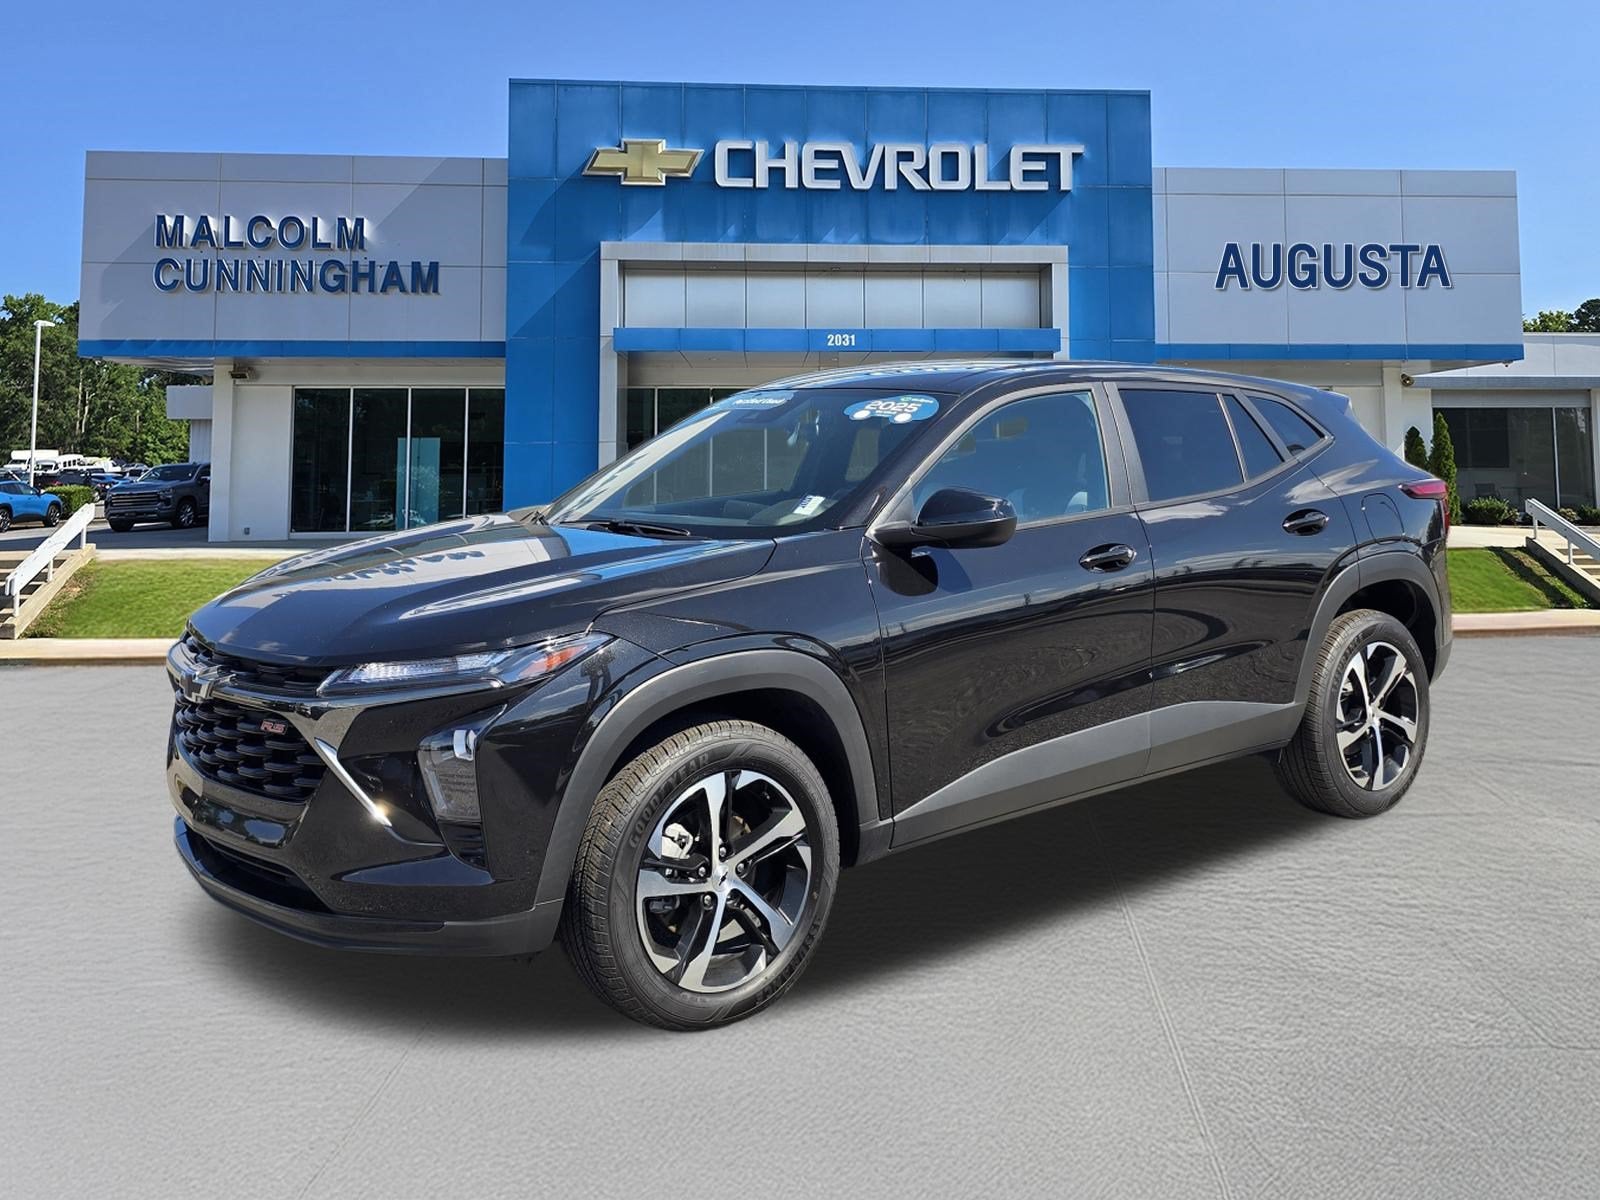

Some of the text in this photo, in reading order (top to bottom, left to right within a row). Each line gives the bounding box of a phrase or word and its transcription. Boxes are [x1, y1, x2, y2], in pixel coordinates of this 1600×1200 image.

[714, 139, 1084, 191] CHEVROLET
[154, 214, 366, 250] MALCOLM
[153, 257, 440, 294] CUNNINGHAM
[1215, 241, 1452, 289] AUGUSTA
[827, 333, 856, 346] 2031
[864, 400, 921, 413] 2025
[629, 752, 709, 849] GOODYEAR
